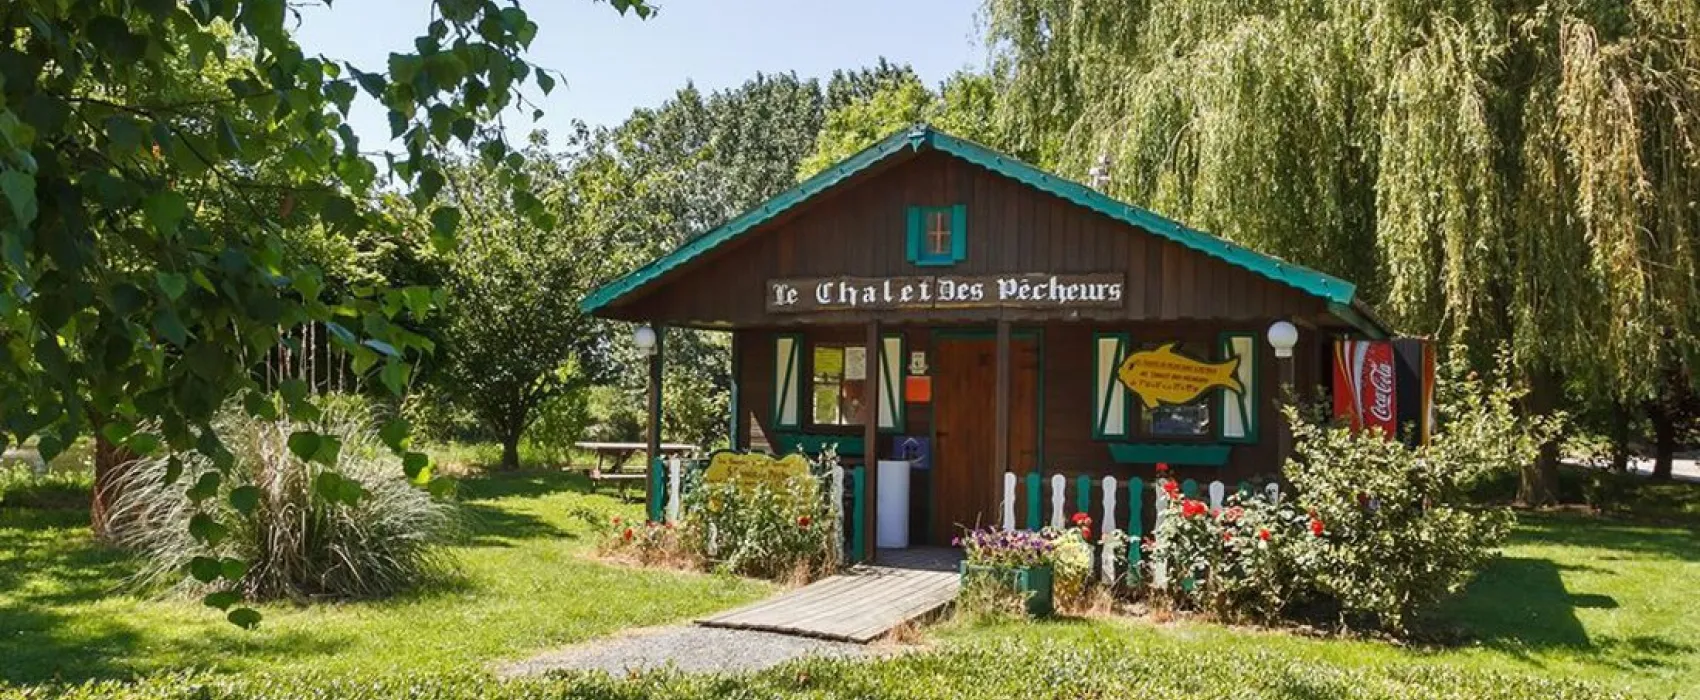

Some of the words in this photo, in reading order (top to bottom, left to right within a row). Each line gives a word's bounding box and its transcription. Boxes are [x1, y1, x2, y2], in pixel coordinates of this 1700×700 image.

[772, 282, 799, 306] Le
[815, 279, 931, 306] Chalet
[937, 278, 984, 301] Des
[997, 275, 1122, 305] Pêcheurs
